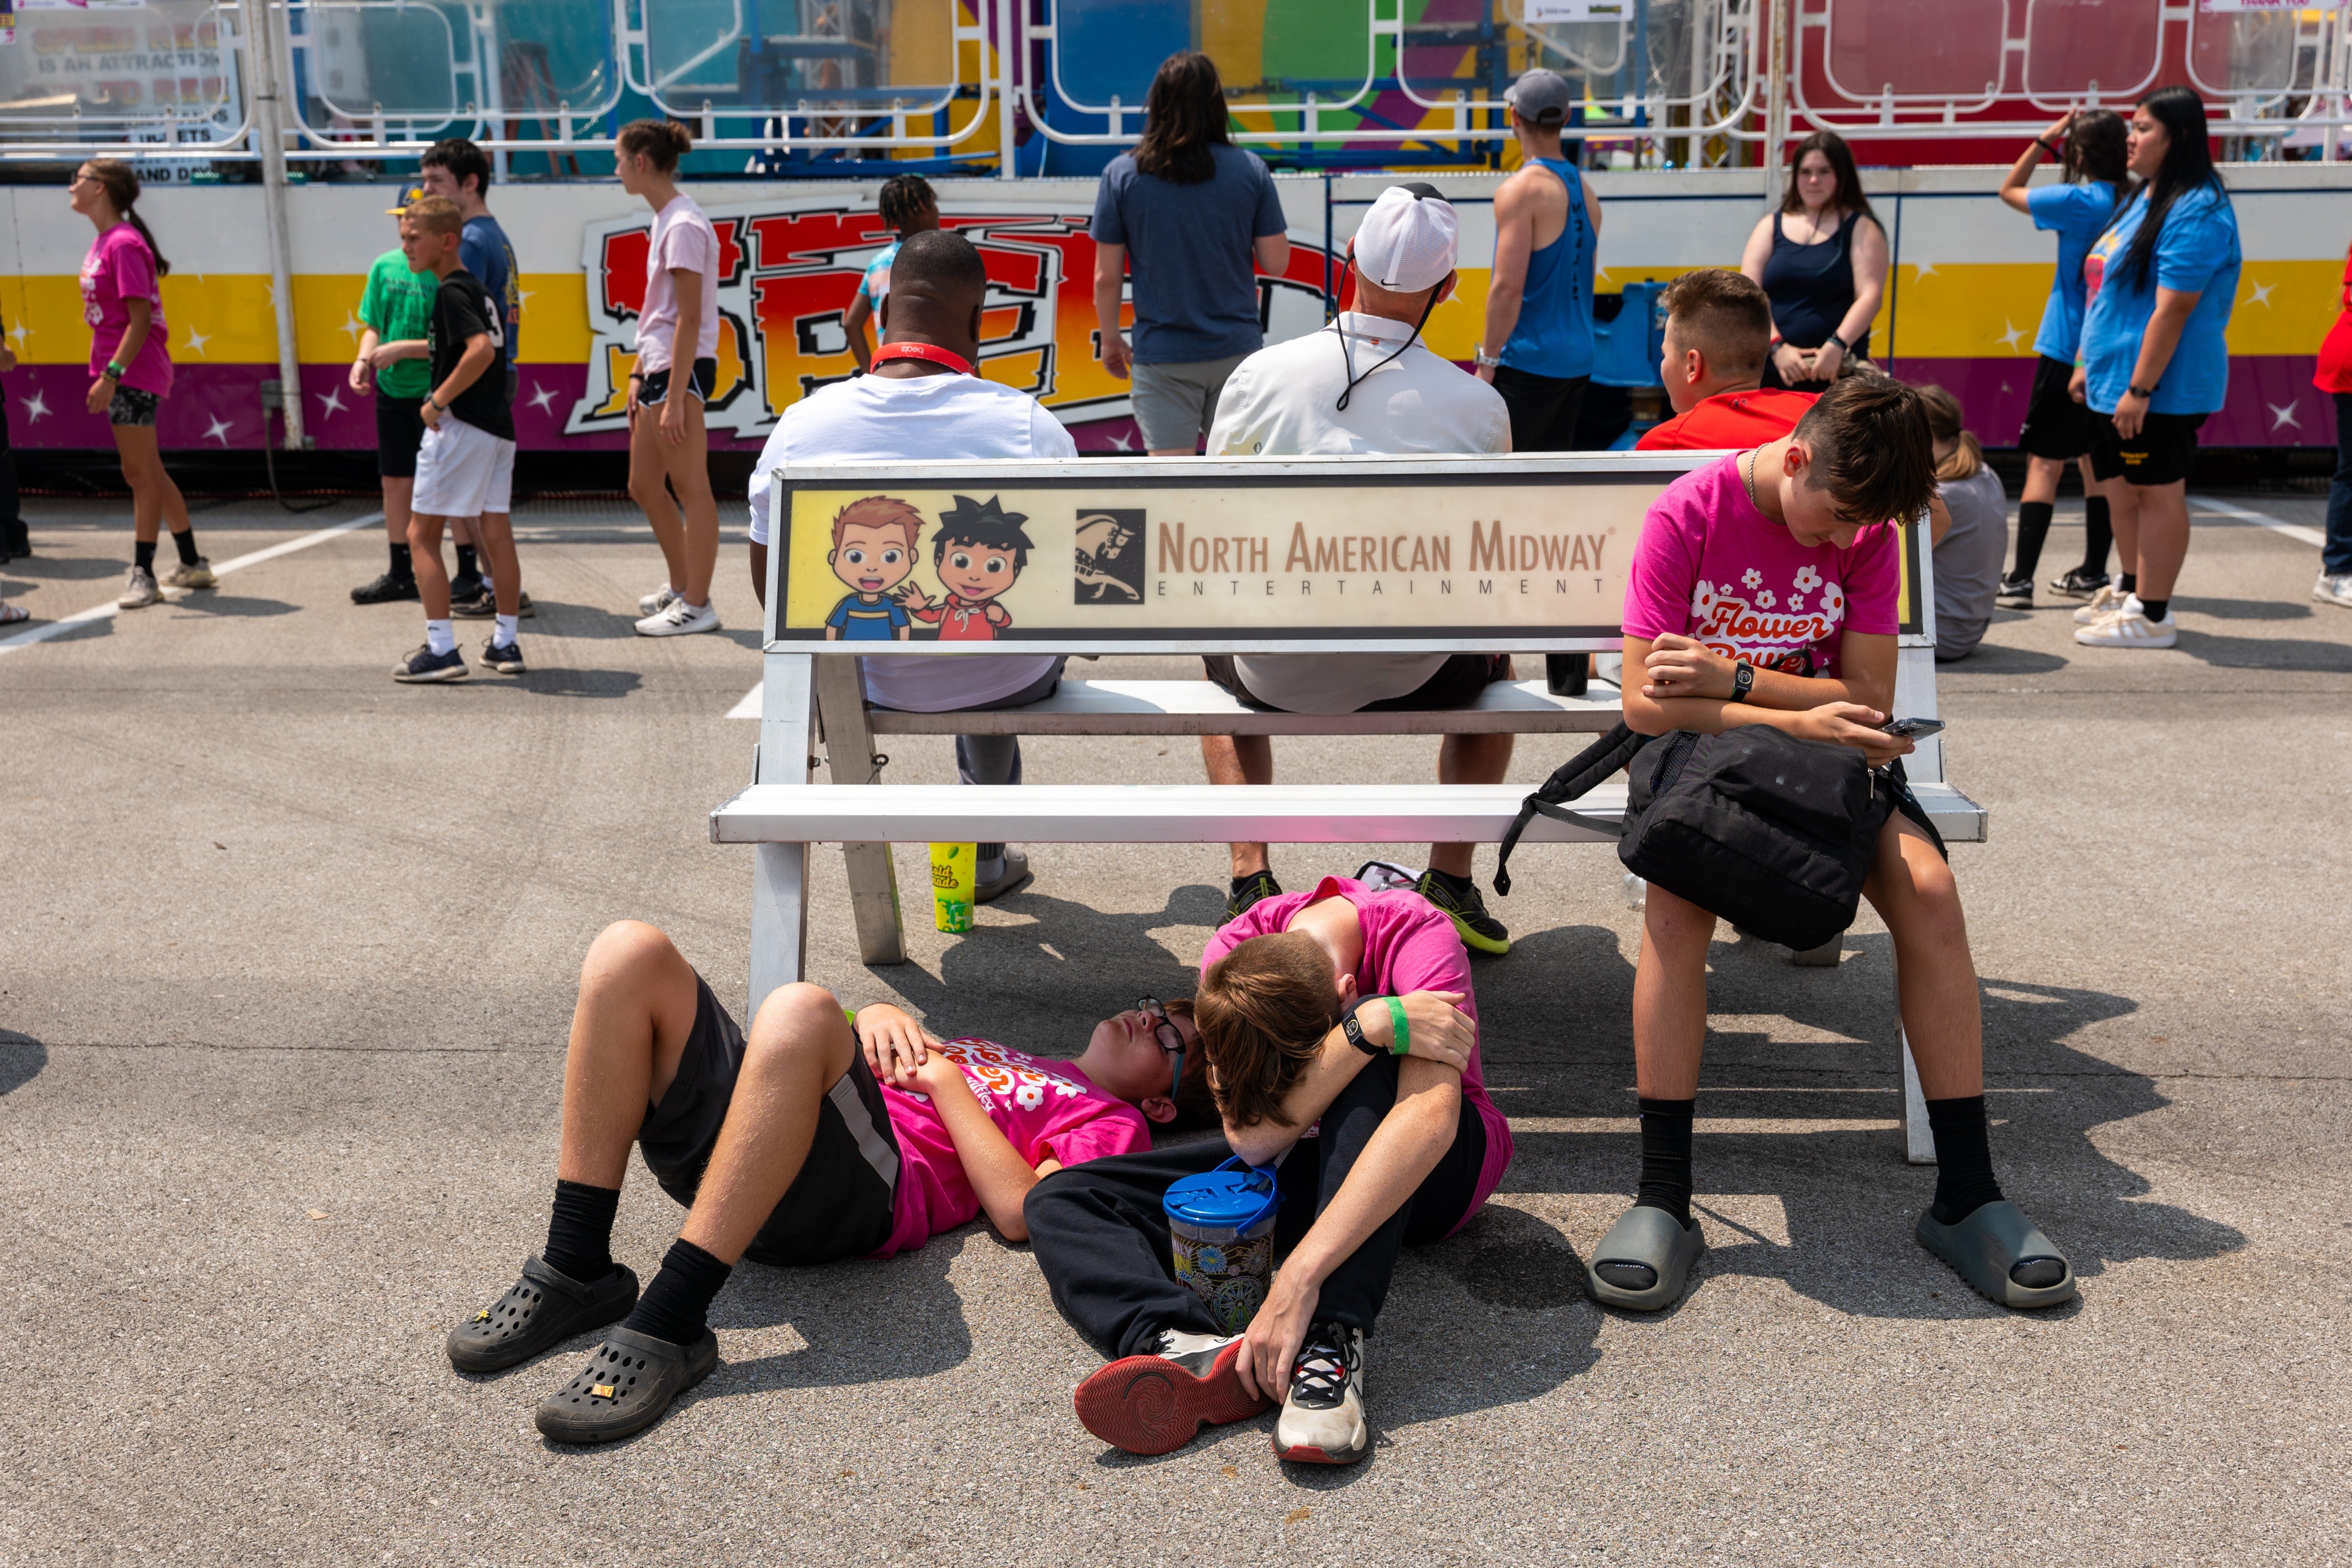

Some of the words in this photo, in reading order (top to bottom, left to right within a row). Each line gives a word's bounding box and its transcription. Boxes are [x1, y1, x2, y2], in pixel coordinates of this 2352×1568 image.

[38, 59, 56, 73] IS
[136, 167, 171, 181] AND
[901, 346, 924, 355] beats
[1158, 522, 1268, 573] NORTH
[1284, 521, 1451, 573] AMERICAN
[1158, 578, 1603, 596] ENTERTAINMENT
[1700, 600, 1830, 640] Flower
[1178, 1270, 1192, 1282] the
